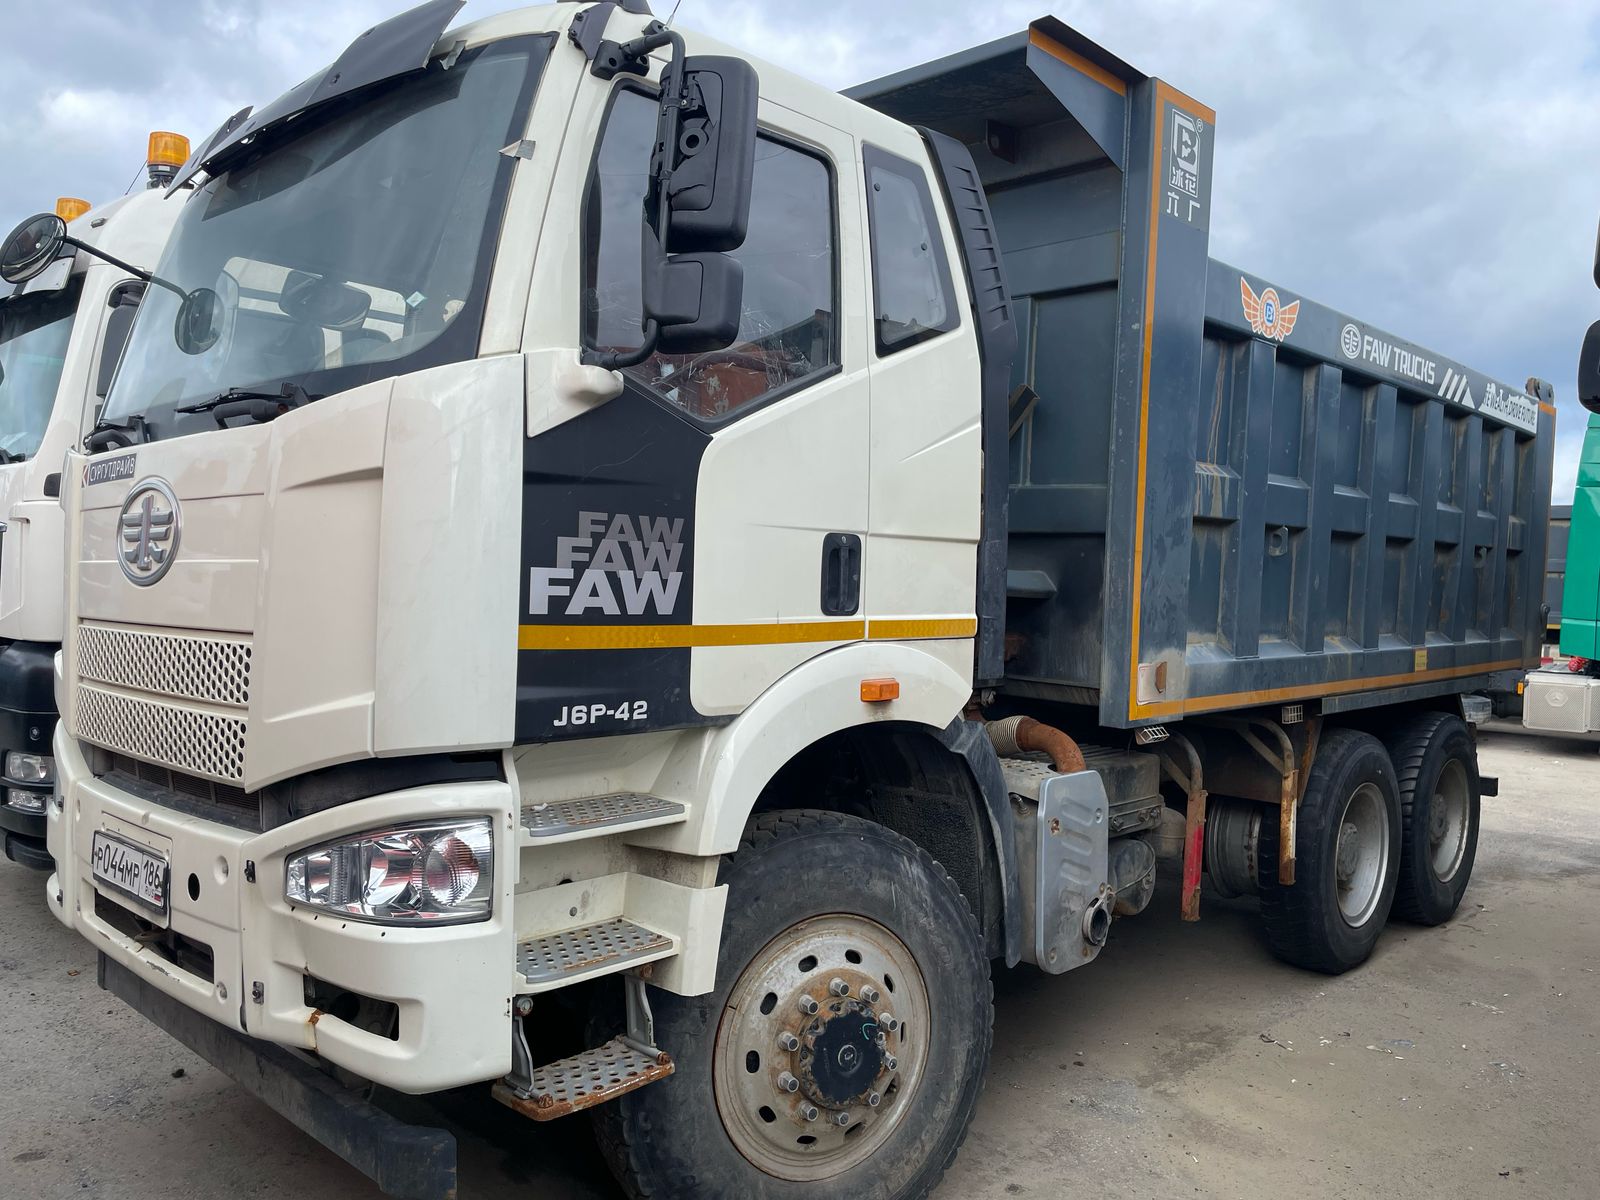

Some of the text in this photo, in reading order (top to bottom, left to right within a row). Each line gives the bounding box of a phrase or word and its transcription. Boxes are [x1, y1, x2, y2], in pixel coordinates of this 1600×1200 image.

[1171, 166, 1197, 194] 冰花
[1362, 335, 1436, 385] FAW TRUCKS
[90, 456, 135, 482] СУРГУТДРАЙВ
[578, 511, 685, 550] FAW
[556, 536, 684, 580] FAW
[529, 567, 683, 615] FAW
[553, 700, 648, 727] J6P-42
[143, 860, 160, 890] 186
